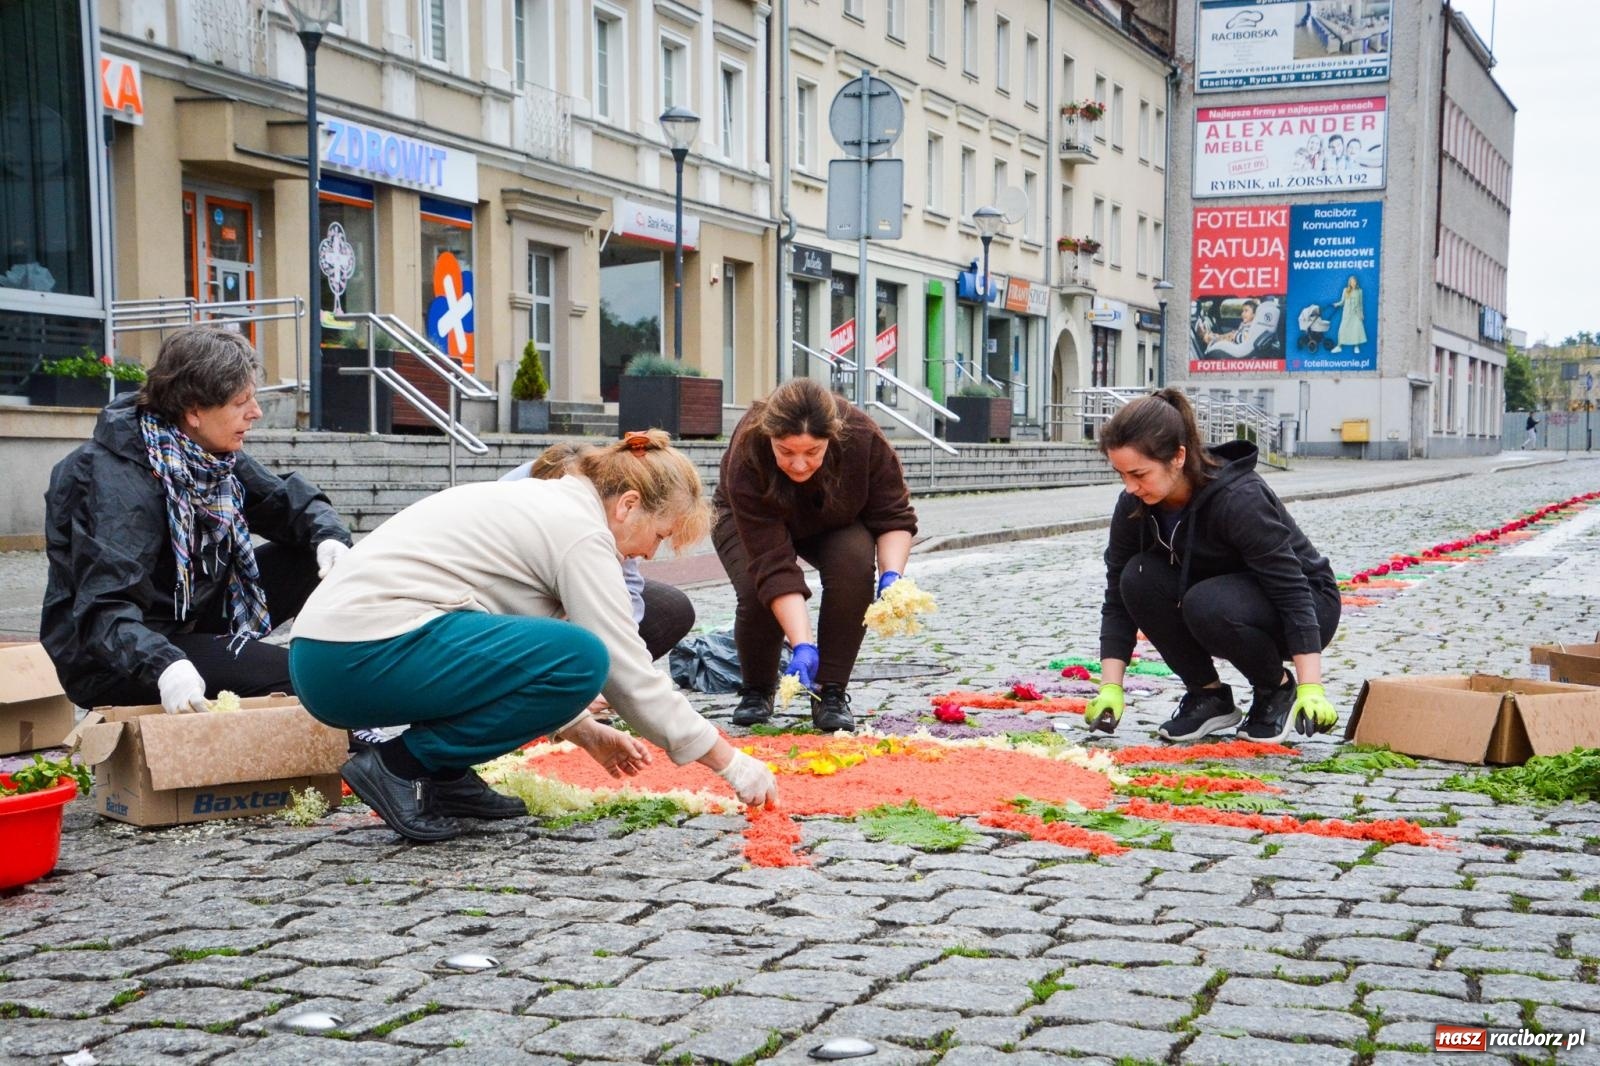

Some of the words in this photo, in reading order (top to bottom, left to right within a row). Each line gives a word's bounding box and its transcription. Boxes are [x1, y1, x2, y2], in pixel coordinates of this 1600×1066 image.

[1211, 28, 1278, 41] RACIBORSKA
[1249, 75, 1278, 85] Rynek
[1281, 73, 1296, 82] 8/9
[1301, 71, 1318, 80] tel.
[1321, 71, 1332, 79] 32
[1357, 68, 1367, 76] 31
[1371, 67, 1384, 75] 74
[1208, 108, 1251, 120] Najlepsze
[1253, 106, 1276, 117] firmy
[1287, 102, 1339, 115] najlepszych
[1341, 100, 1374, 111] cenach
[1205, 115, 1376, 139] ALEXANDER
[328, 121, 447, 187] ZDROWIT
[1204, 139, 1264, 154] MEBLE
[1211, 178, 1265, 191] RYBNIK,
[1268, 177, 1284, 188] ul.
[1349, 173, 1368, 185] 192
[1196, 210, 1287, 229] FOTELIKI
[1314, 208, 1356, 218] Racibórz
[1302, 221, 1359, 230] Komunalna
[1362, 219, 1368, 228] 7
[1197, 237, 1285, 261] RATUJĄ
[1313, 237, 1355, 246] FOTELIKI
[1294, 248, 1375, 259] SAMOCHODOWE
[1293, 260, 1325, 270] WÓZKI
[1327, 260, 1375, 270] DZIECIĘCE
[1198, 264, 1280, 289] ŻYCIE!
[1197, 360, 1278, 371] FOTELIKOWANIE
[1303, 358, 1370, 369] fotelikowanie.pl
